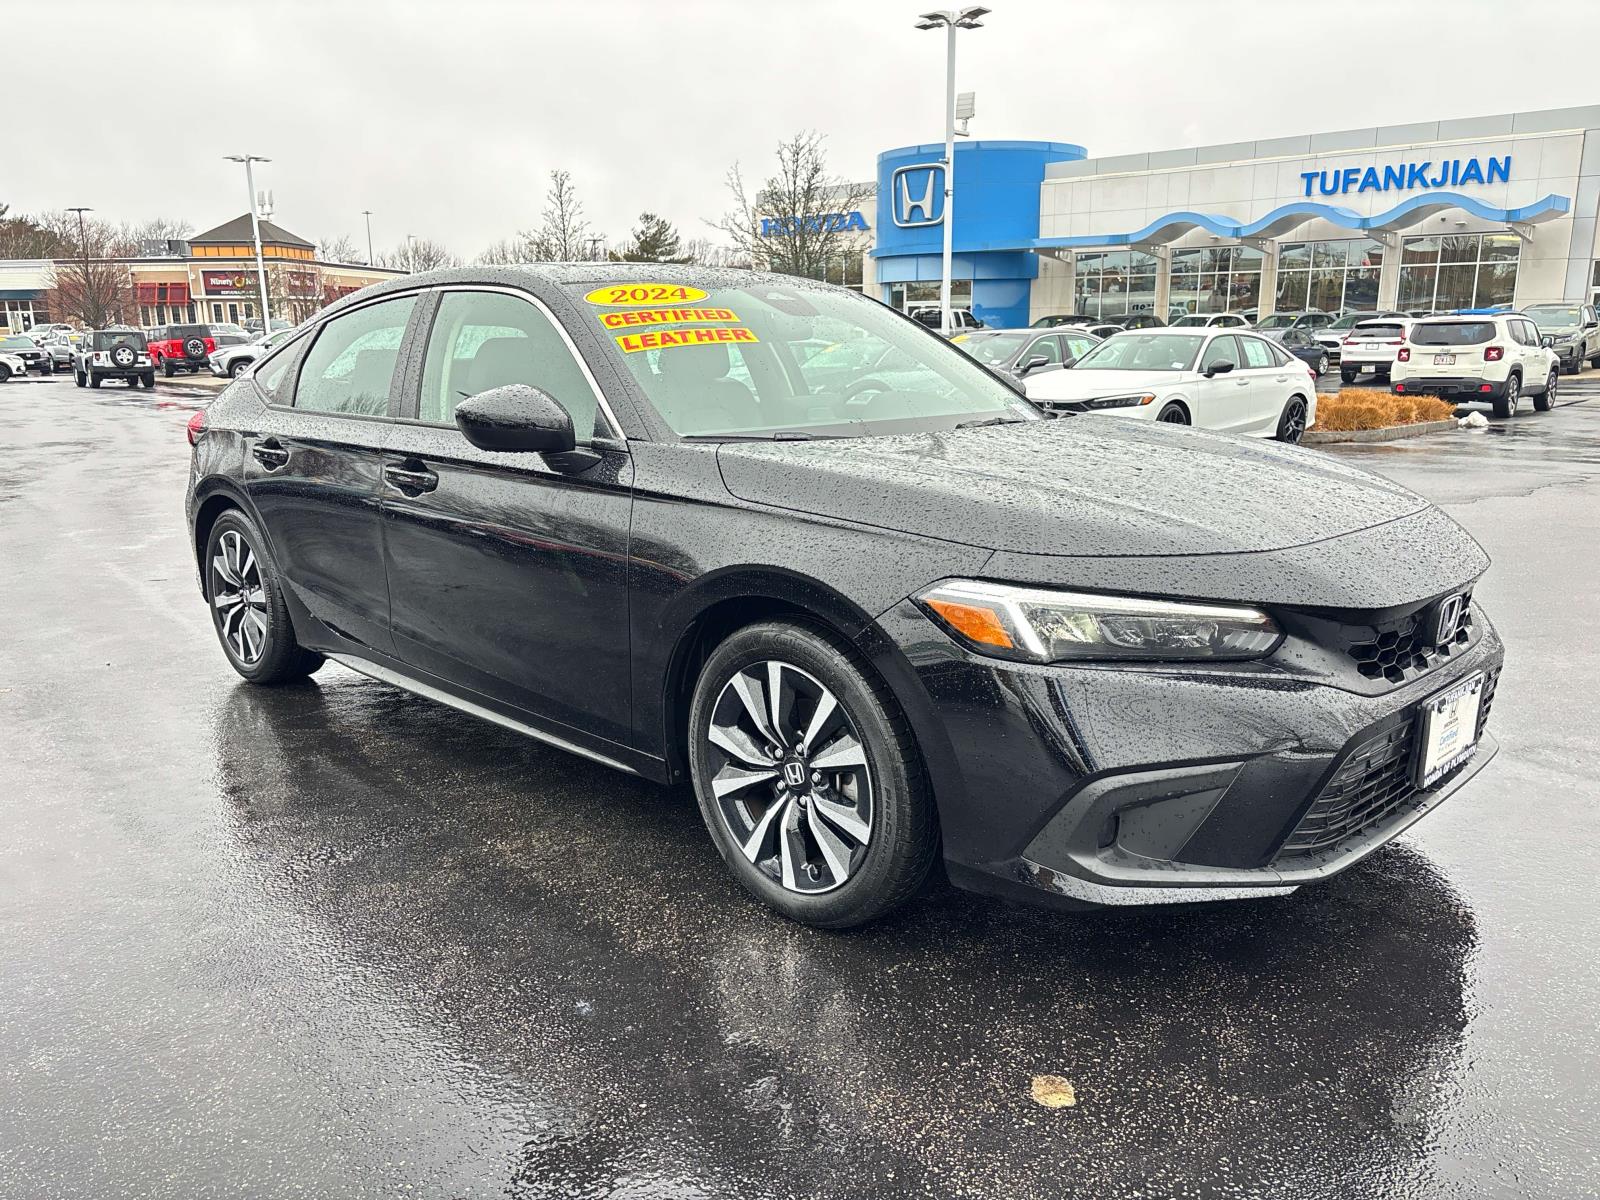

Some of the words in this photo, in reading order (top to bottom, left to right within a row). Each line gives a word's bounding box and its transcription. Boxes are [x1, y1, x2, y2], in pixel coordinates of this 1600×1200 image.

[1301, 155, 1512, 197] TUFANKJIAN
[760, 211, 871, 238] HONDA
[609, 287, 690, 304] 2024
[605, 309, 733, 327] CERTIFIED
[622, 329, 753, 351] LEATHER
